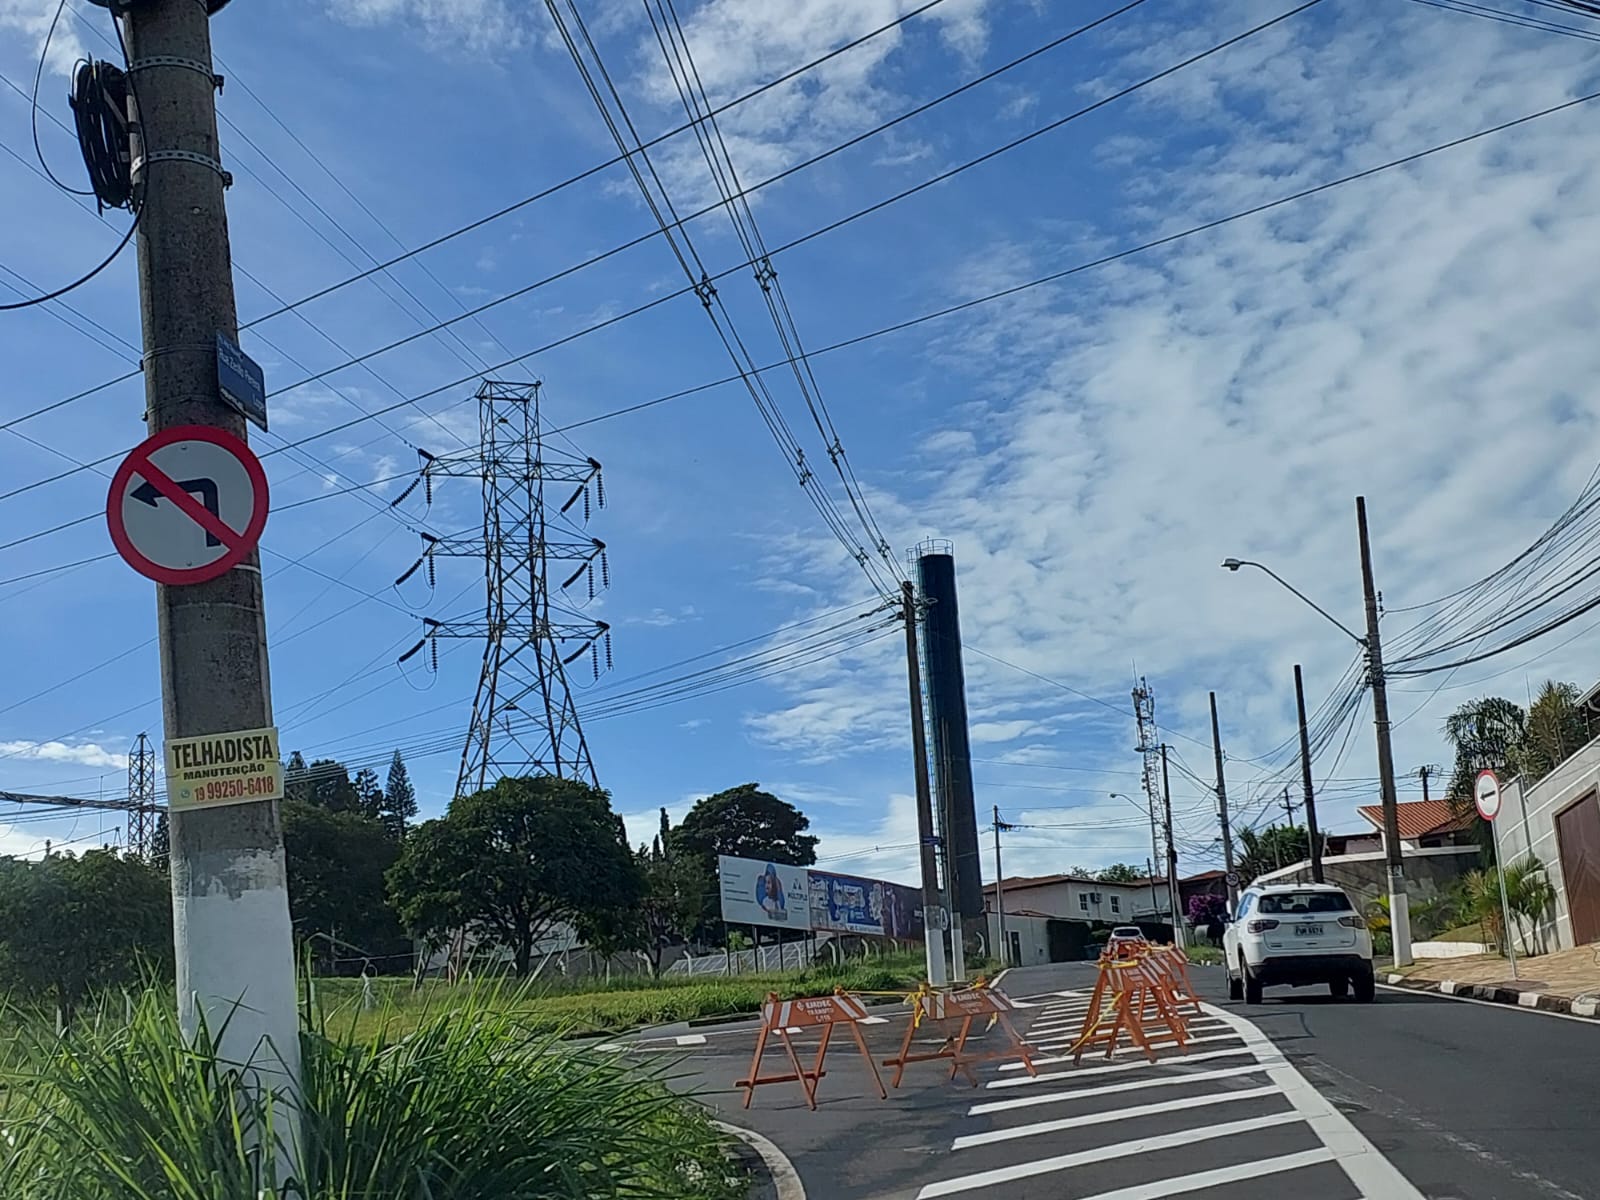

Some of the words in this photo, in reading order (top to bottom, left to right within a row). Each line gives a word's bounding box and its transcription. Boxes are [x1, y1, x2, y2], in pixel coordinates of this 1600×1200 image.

[172, 735, 273, 769] TELHADISTA
[183, 762, 266, 780] MANUTENÇÃO
[195, 787, 206, 801] 19
[207, 775, 274, 800] 99250-6418
